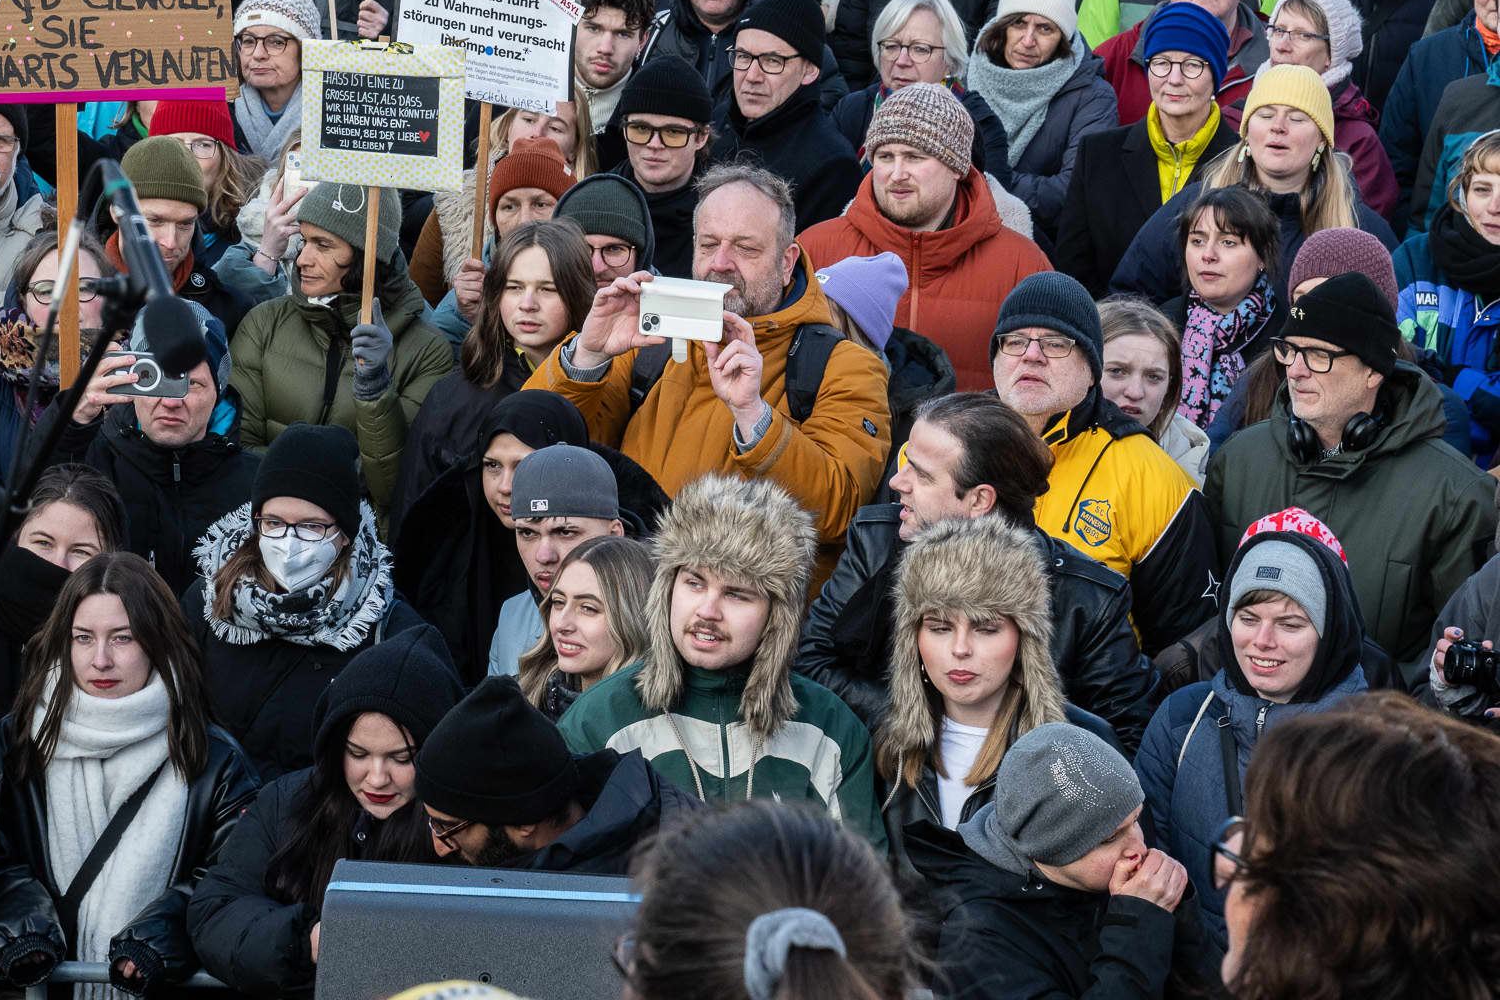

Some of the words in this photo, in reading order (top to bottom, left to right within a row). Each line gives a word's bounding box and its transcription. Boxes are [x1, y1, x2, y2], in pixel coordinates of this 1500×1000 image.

[34, 14, 105, 50] SIE
[403, 9, 467, 31] störungen
[470, 24, 494, 38] und
[497, 29, 566, 53] verursacht
[92, 46, 240, 90] VERLAUFEN
[325, 71, 349, 87] HASS
[350, 73, 366, 88] IST
[367, 75, 391, 90] EINE
[392, 77, 405, 90] ZU
[325, 88, 355, 103] GROSSE
[357, 91, 380, 106] LAST,
[380, 93, 398, 106] ALS
[398, 94, 423, 108] DASS
[325, 102, 342, 113] WIR
[343, 103, 359, 115] IHN
[363, 104, 397, 118] TRAGEN
[398, 106, 440, 121] KÖNNTEN!
[326, 113, 343, 125] WIR
[343, 114, 370, 127] HABEN
[371, 117, 389, 128] UNS
[389, 118, 411, 129] ENT-
[325, 124, 363, 140] SCHIEDEN,
[363, 128, 378, 139] BEI
[378, 130, 395, 141] DER
[397, 130, 421, 143] LIEBE
